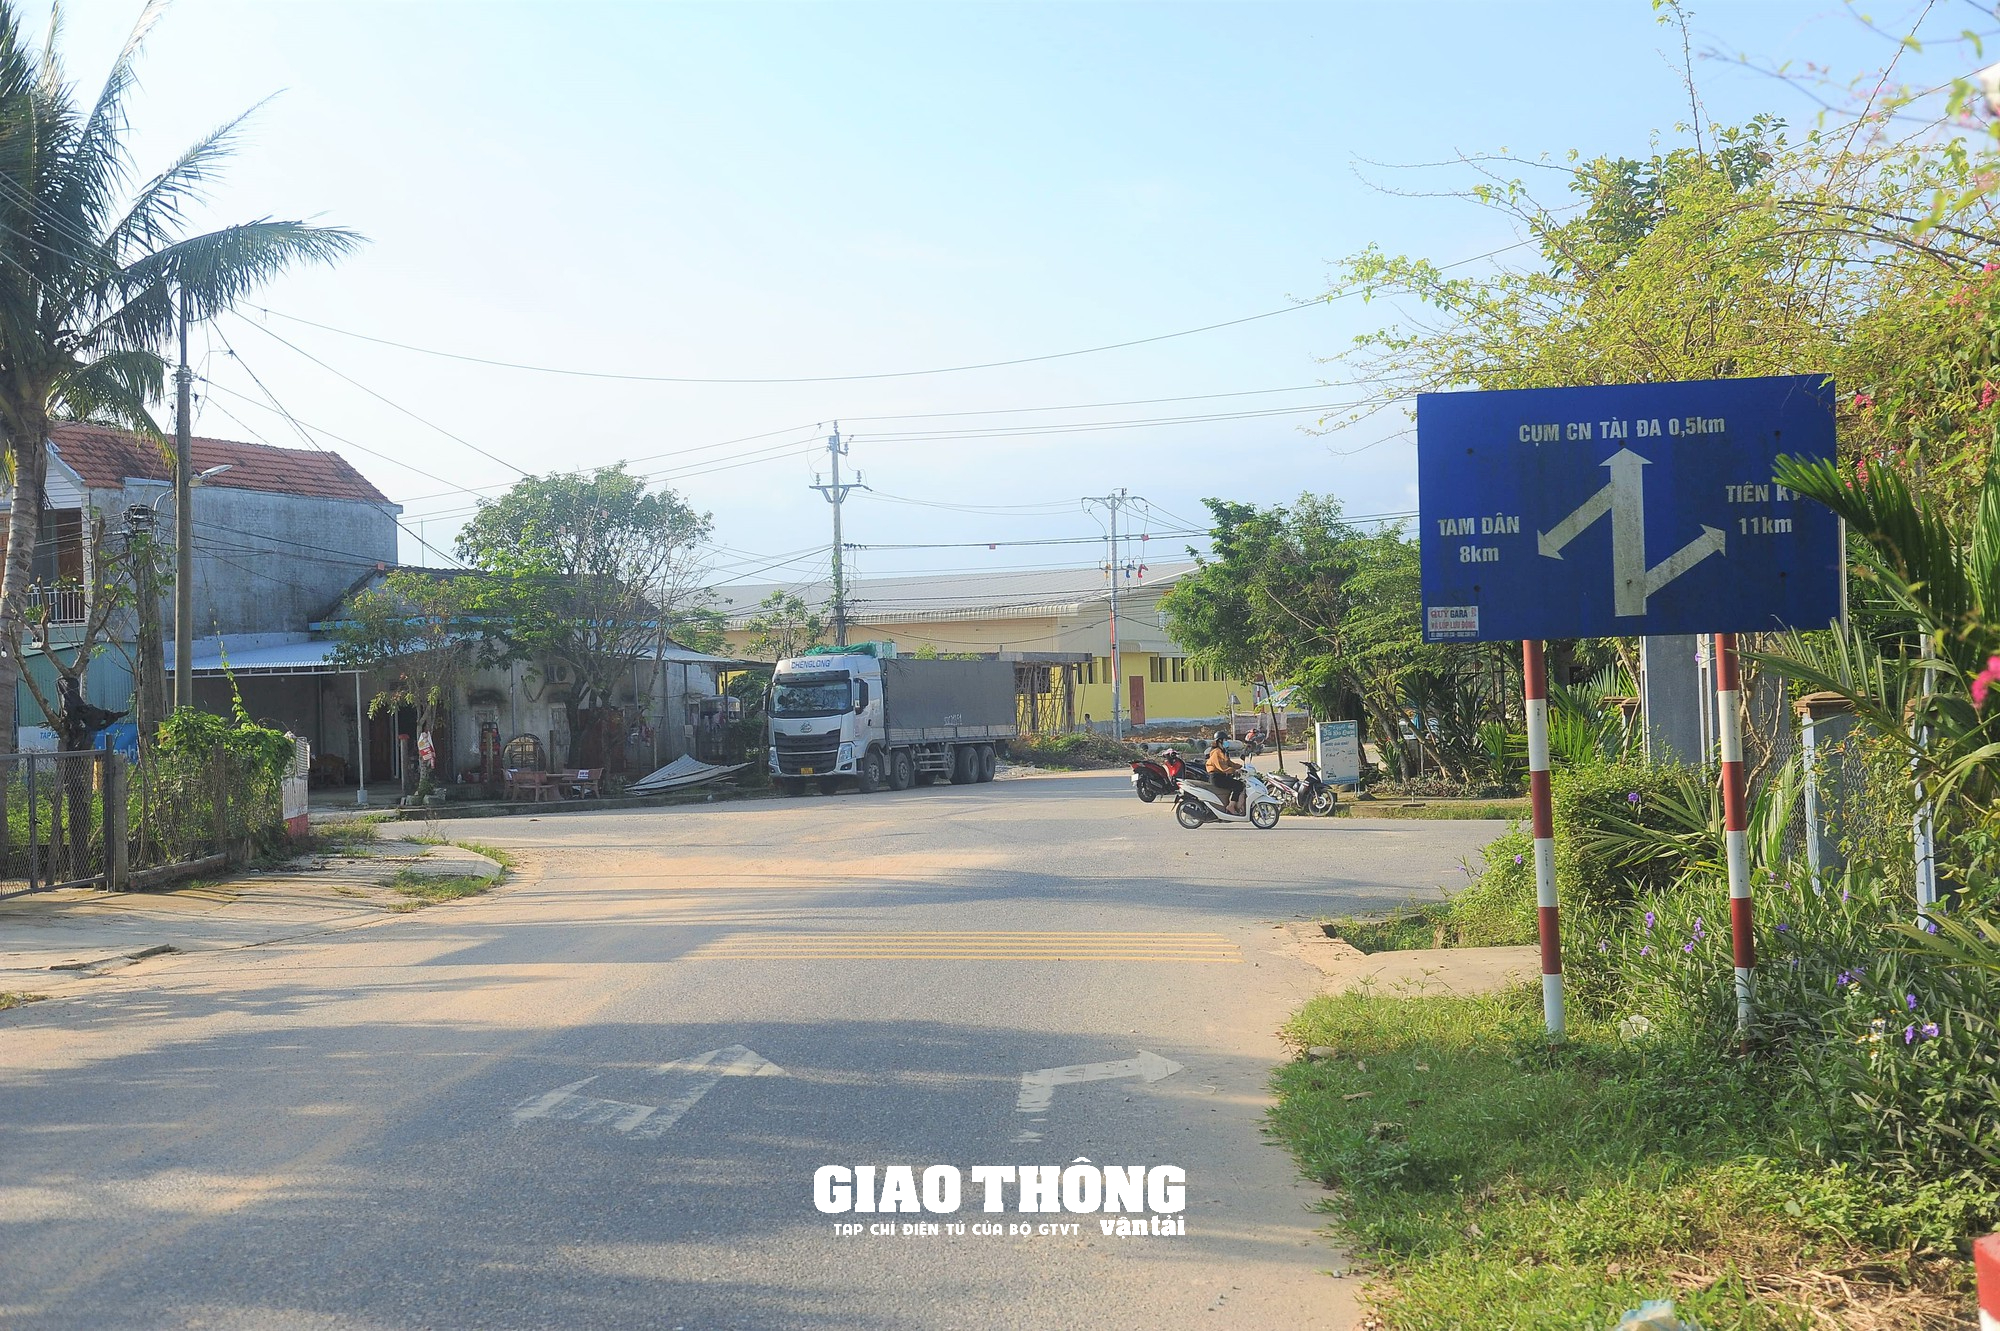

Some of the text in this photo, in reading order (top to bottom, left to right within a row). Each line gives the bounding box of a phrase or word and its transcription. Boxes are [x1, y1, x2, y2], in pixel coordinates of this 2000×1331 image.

[1519, 416, 1725, 446] CỤM CN TÀI ĐA 0,5km
[1725, 481, 1769, 503] TIÊN
[1437, 512, 1520, 536] TAM DÂN
[1738, 516, 1792, 535] 11km
[1459, 545, 1499, 563] 8km
[1450, 610, 1468, 618] GARA
[791, 659, 831, 669] CHENGLONG
